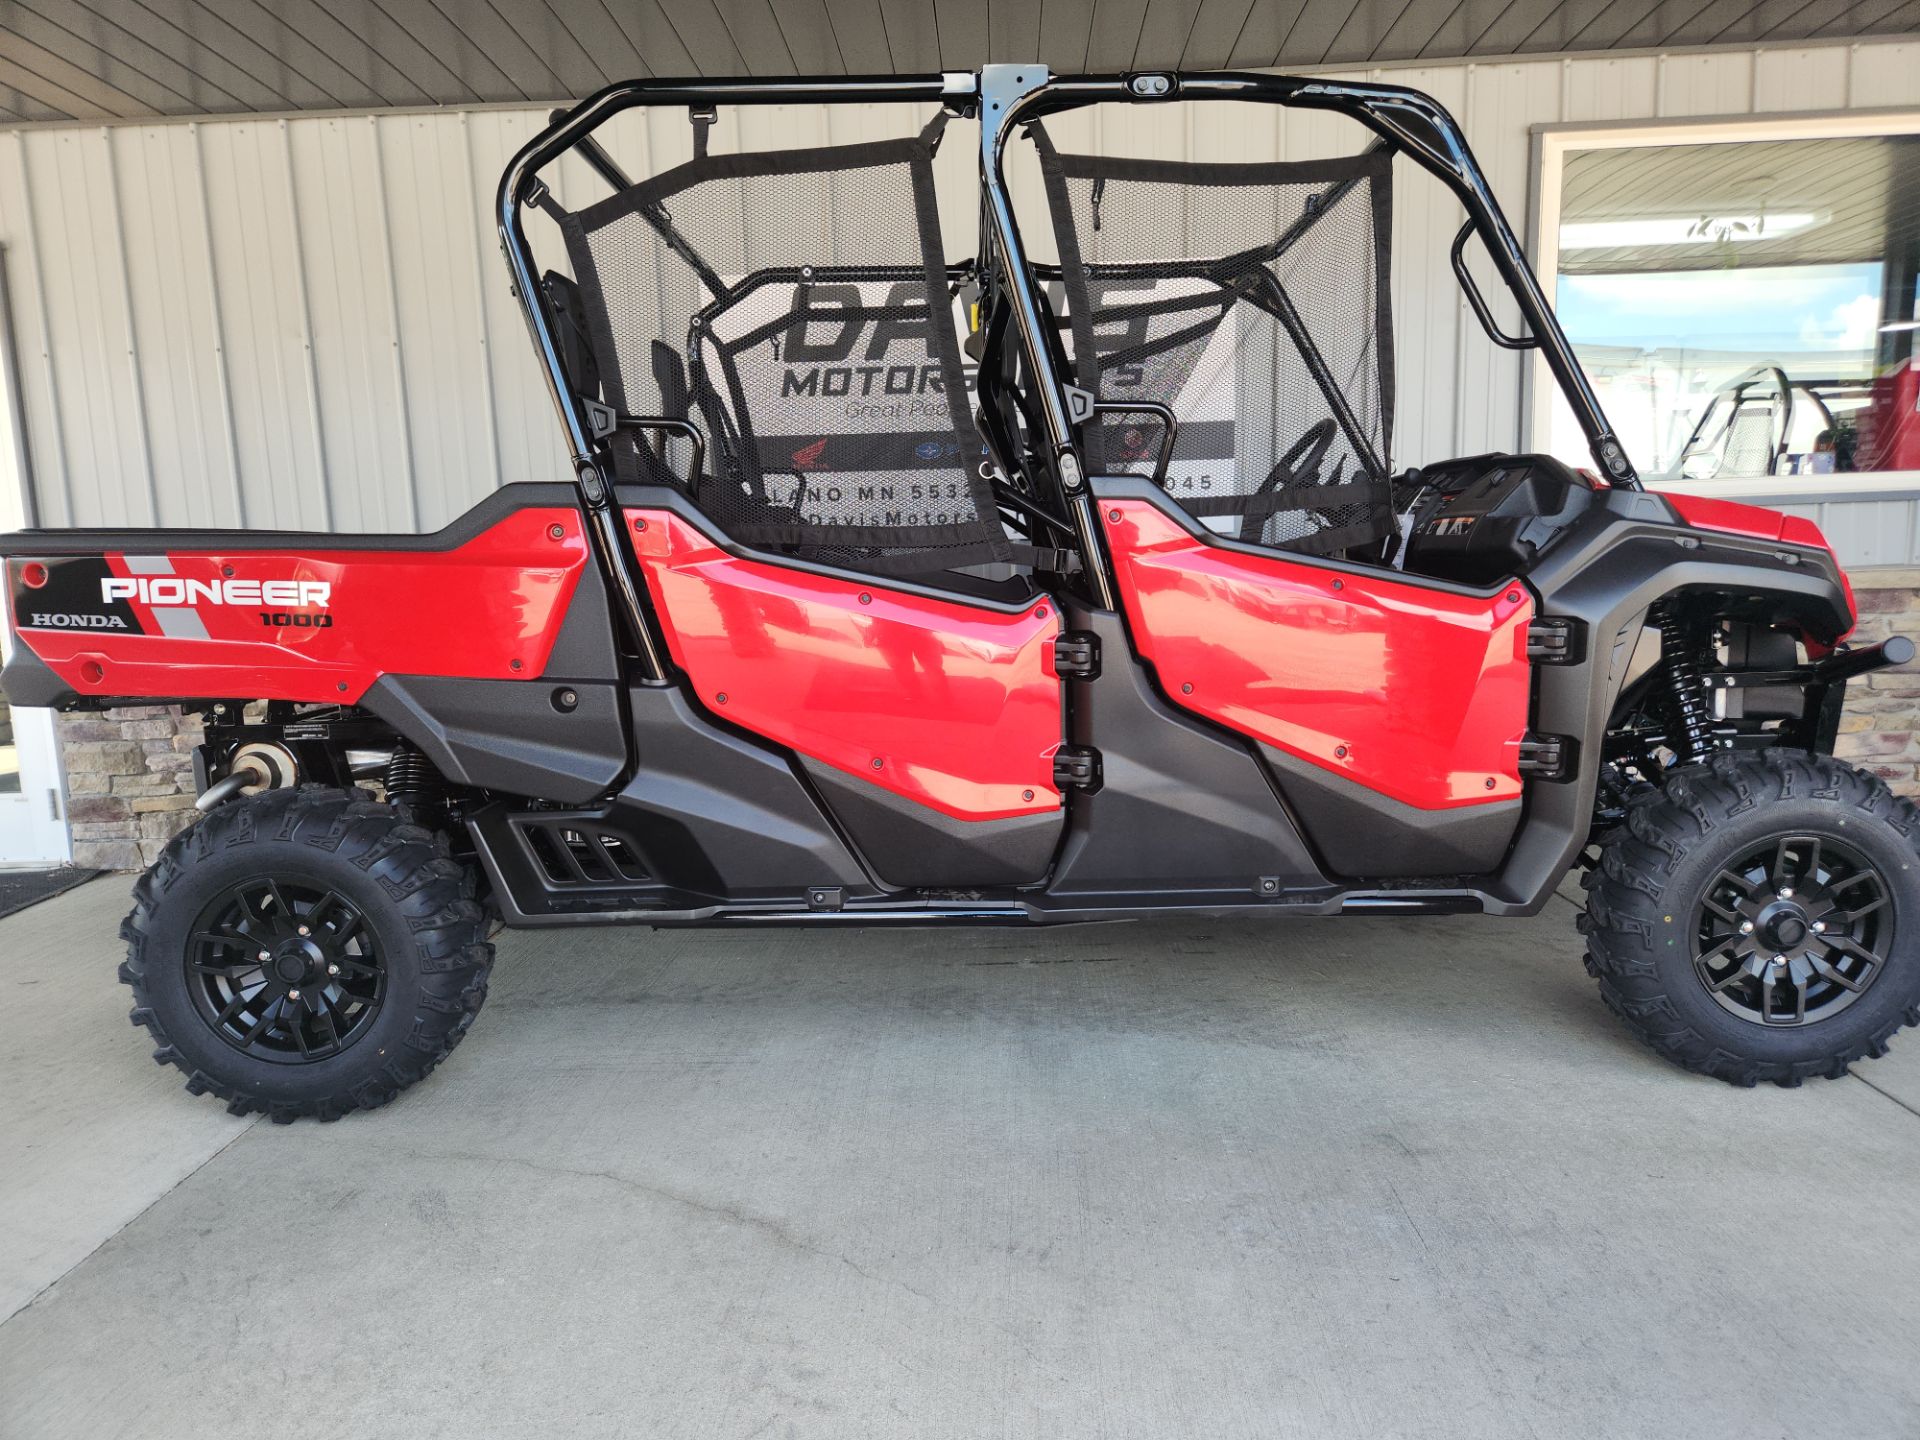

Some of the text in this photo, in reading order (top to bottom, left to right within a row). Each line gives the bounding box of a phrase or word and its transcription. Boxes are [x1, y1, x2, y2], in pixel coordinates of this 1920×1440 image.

[858, 486, 895, 500] MN
[1164, 474, 1212, 491] 045
[101, 577, 331, 607] PIONEER
[31, 612, 128, 628] HONDA
[260, 612, 333, 628] 1000
